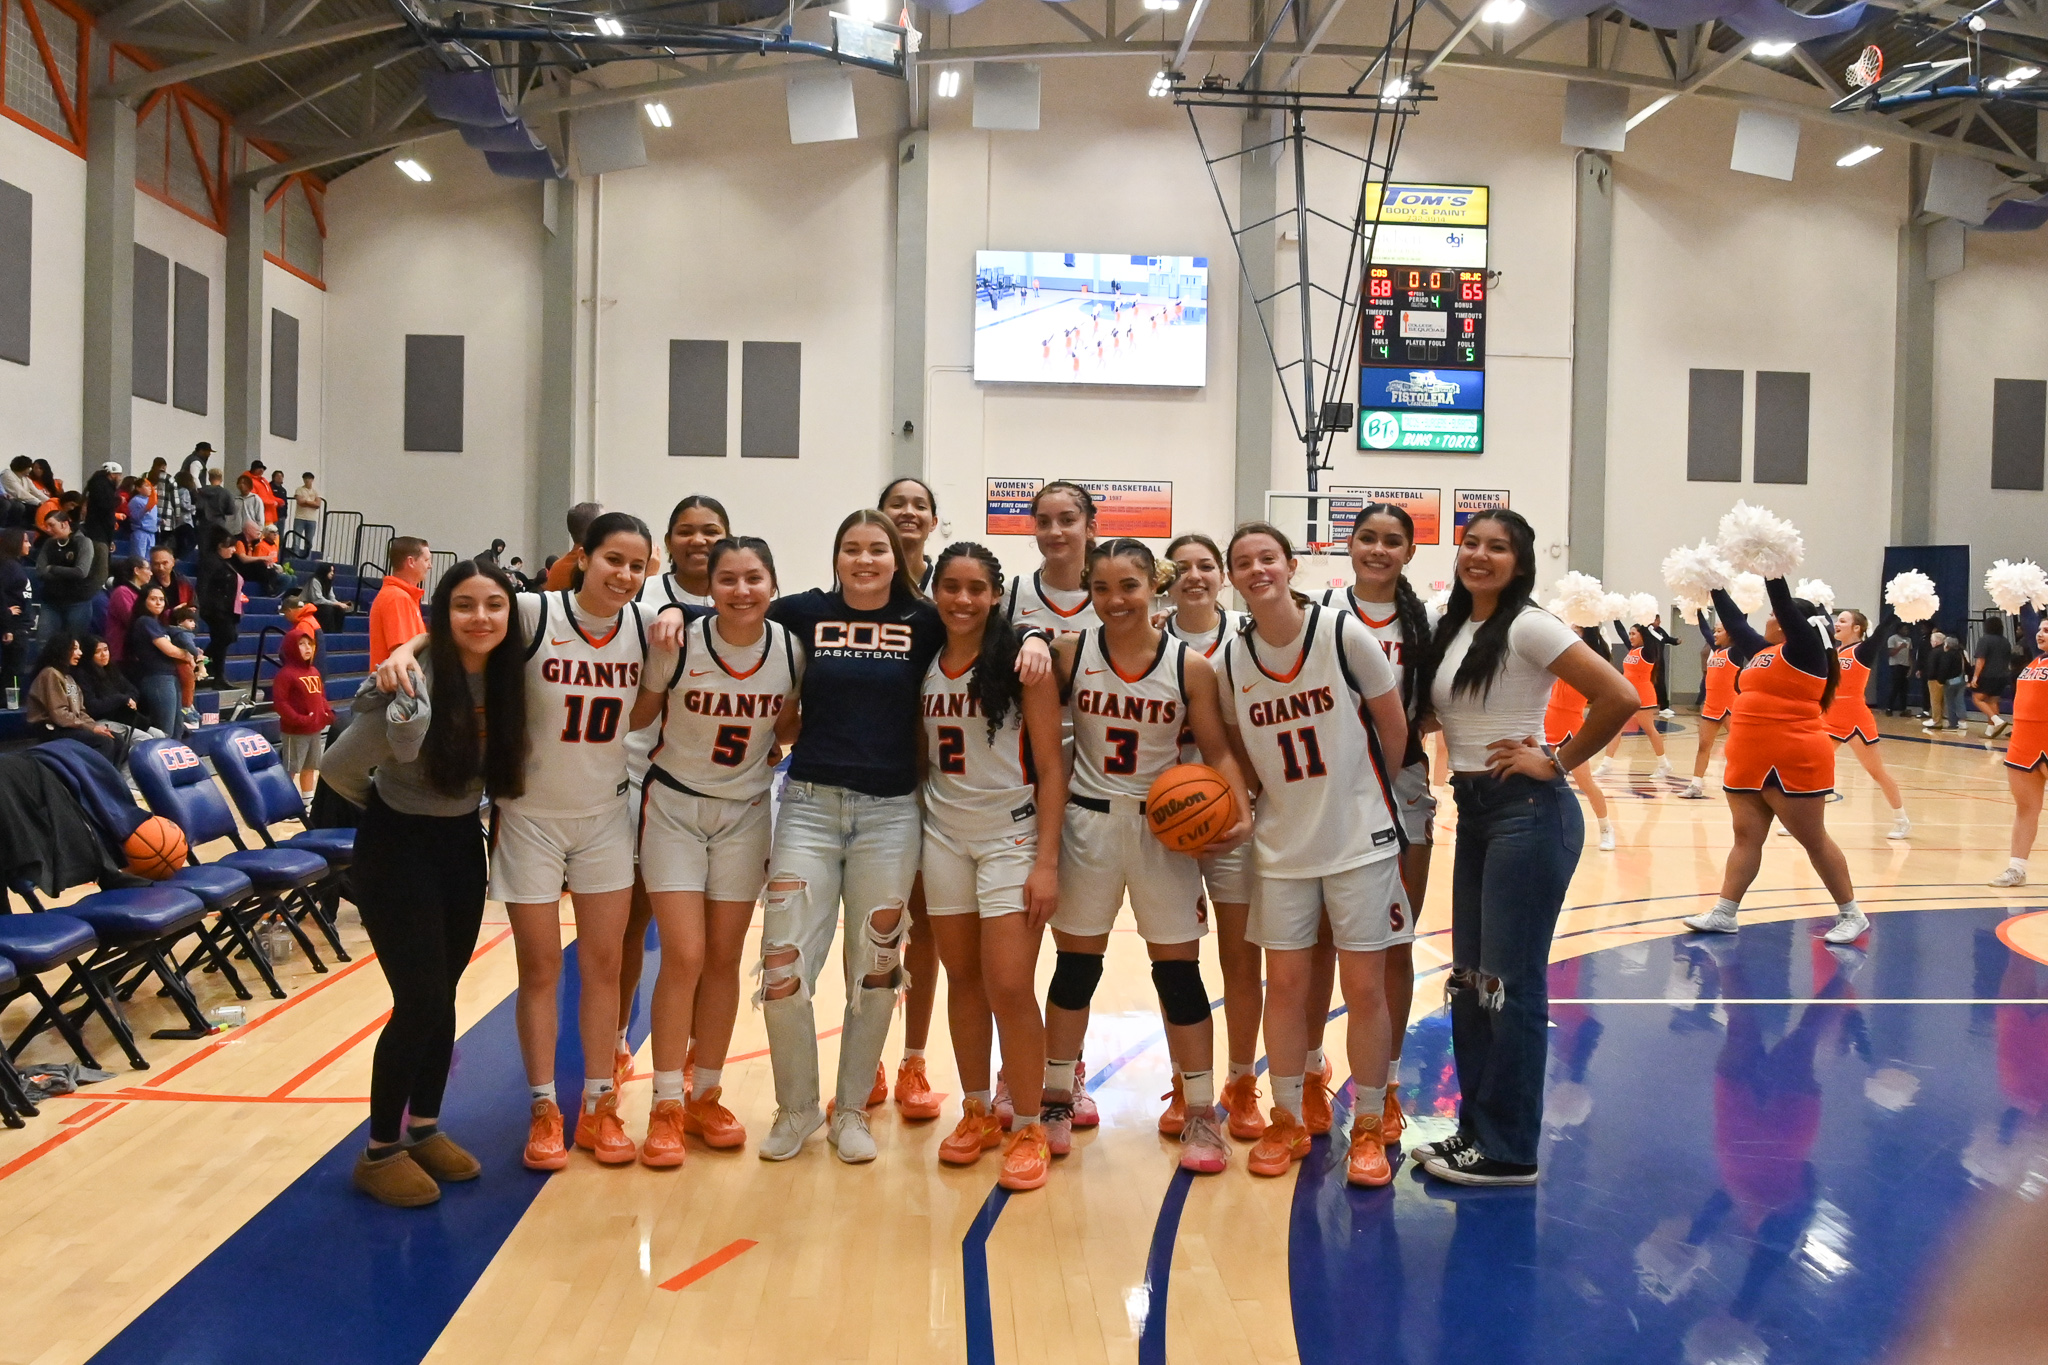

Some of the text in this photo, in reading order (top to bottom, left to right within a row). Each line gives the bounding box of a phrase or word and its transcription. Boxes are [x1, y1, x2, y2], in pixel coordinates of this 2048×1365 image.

[1371, 269, 1387, 277] COS
[1460, 272, 1482, 281] SRJC
[1370, 279, 1392, 297] 68
[1462, 282, 1483, 300] 65
[1431, 295, 1440, 308] 4
[1374, 315, 1384, 330] 2
[1463, 318, 1474, 332] 0
[1380, 345, 1388, 358] 4
[1465, 348, 1474, 361] 5
[1403, 433, 1433, 446] BUNS
[1441, 435, 1479, 448] TORTS
[1076, 483, 1162, 492] OMEN'S BASKETBALL
[1375, 491, 1424, 499] BASKETBALL
[1332, 578, 1342, 586] EXIT
[1434, 581, 1444, 589] EXIT
[814, 621, 912, 652] COS
[814, 649, 910, 661] BASKETBALL
[542, 658, 639, 689] GIANTS
[684, 690, 785, 718] GIANTS
[923, 693, 988, 717] IANT
[1077, 689, 1177, 724] GIANTS
[1249, 685, 1335, 728] GIANTS
[560, 694, 623, 743] 10
[235, 734, 271, 758] COS
[711, 724, 752, 767] 5
[937, 725, 965, 774] 2
[1104, 726, 1139, 775] 3
[1277, 725, 1327, 783] 11
[158, 746, 199, 771] COS
[1151, 791, 1207, 826] Wilson
[1390, 902, 1404, 932] S
